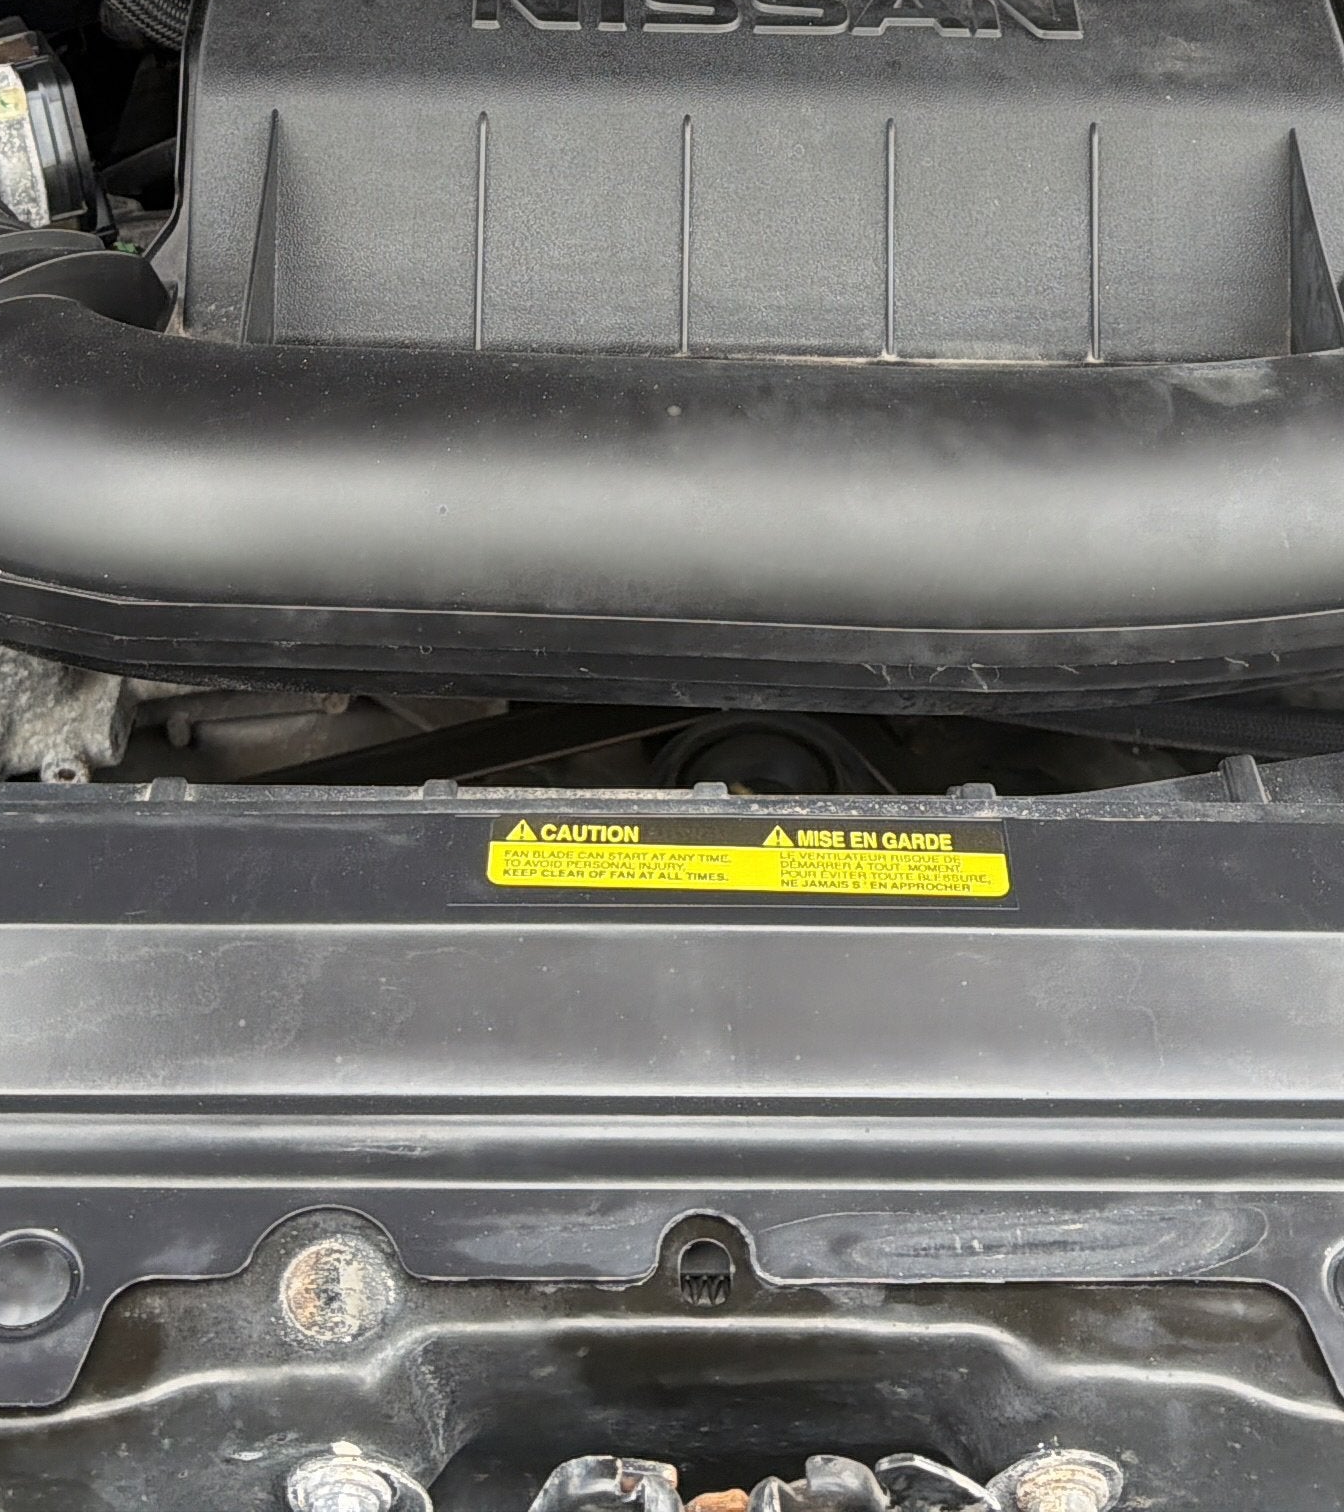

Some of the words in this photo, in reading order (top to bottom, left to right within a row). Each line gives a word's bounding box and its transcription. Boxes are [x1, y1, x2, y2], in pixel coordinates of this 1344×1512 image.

[540, 823, 640, 843] CAUTION
[797, 830, 846, 847] MISE
[850, 831, 878, 849] EN
[881, 833, 953, 851] GARDE
[504, 849, 529, 859] FAN
[532, 850, 574, 859] BLADE
[577, 851, 605, 860] CAN
[608, 852, 648, 861] START
[651, 853, 666, 861] AT
[669, 853, 696, 862] ANY
[698, 853, 732, 863] TIME.
[799, 851, 887, 862] VENTILATEUR
[890, 854, 939, 863] RISQUE
[504, 858, 520, 867] TO
[524, 859, 563, 868] AVOID
[566, 860, 635, 870] PERSONAL
[866, 862, 901, 872] TOUT
[503, 868, 537, 878] KEEP
[541, 869, 585, 878] CLEAR
[588, 870, 606, 879] OF
[609, 870, 635, 880] FAN
[639, 871, 655, 880] AT
[658, 871, 683, 881] ALL
[780, 869, 817, 879] POUR
[870, 871, 913, 881] TOUTE
[780, 878, 798, 887] NE
[801, 879, 849, 889] JAMAIS
[890, 882, 971, 892] APPROCHER
